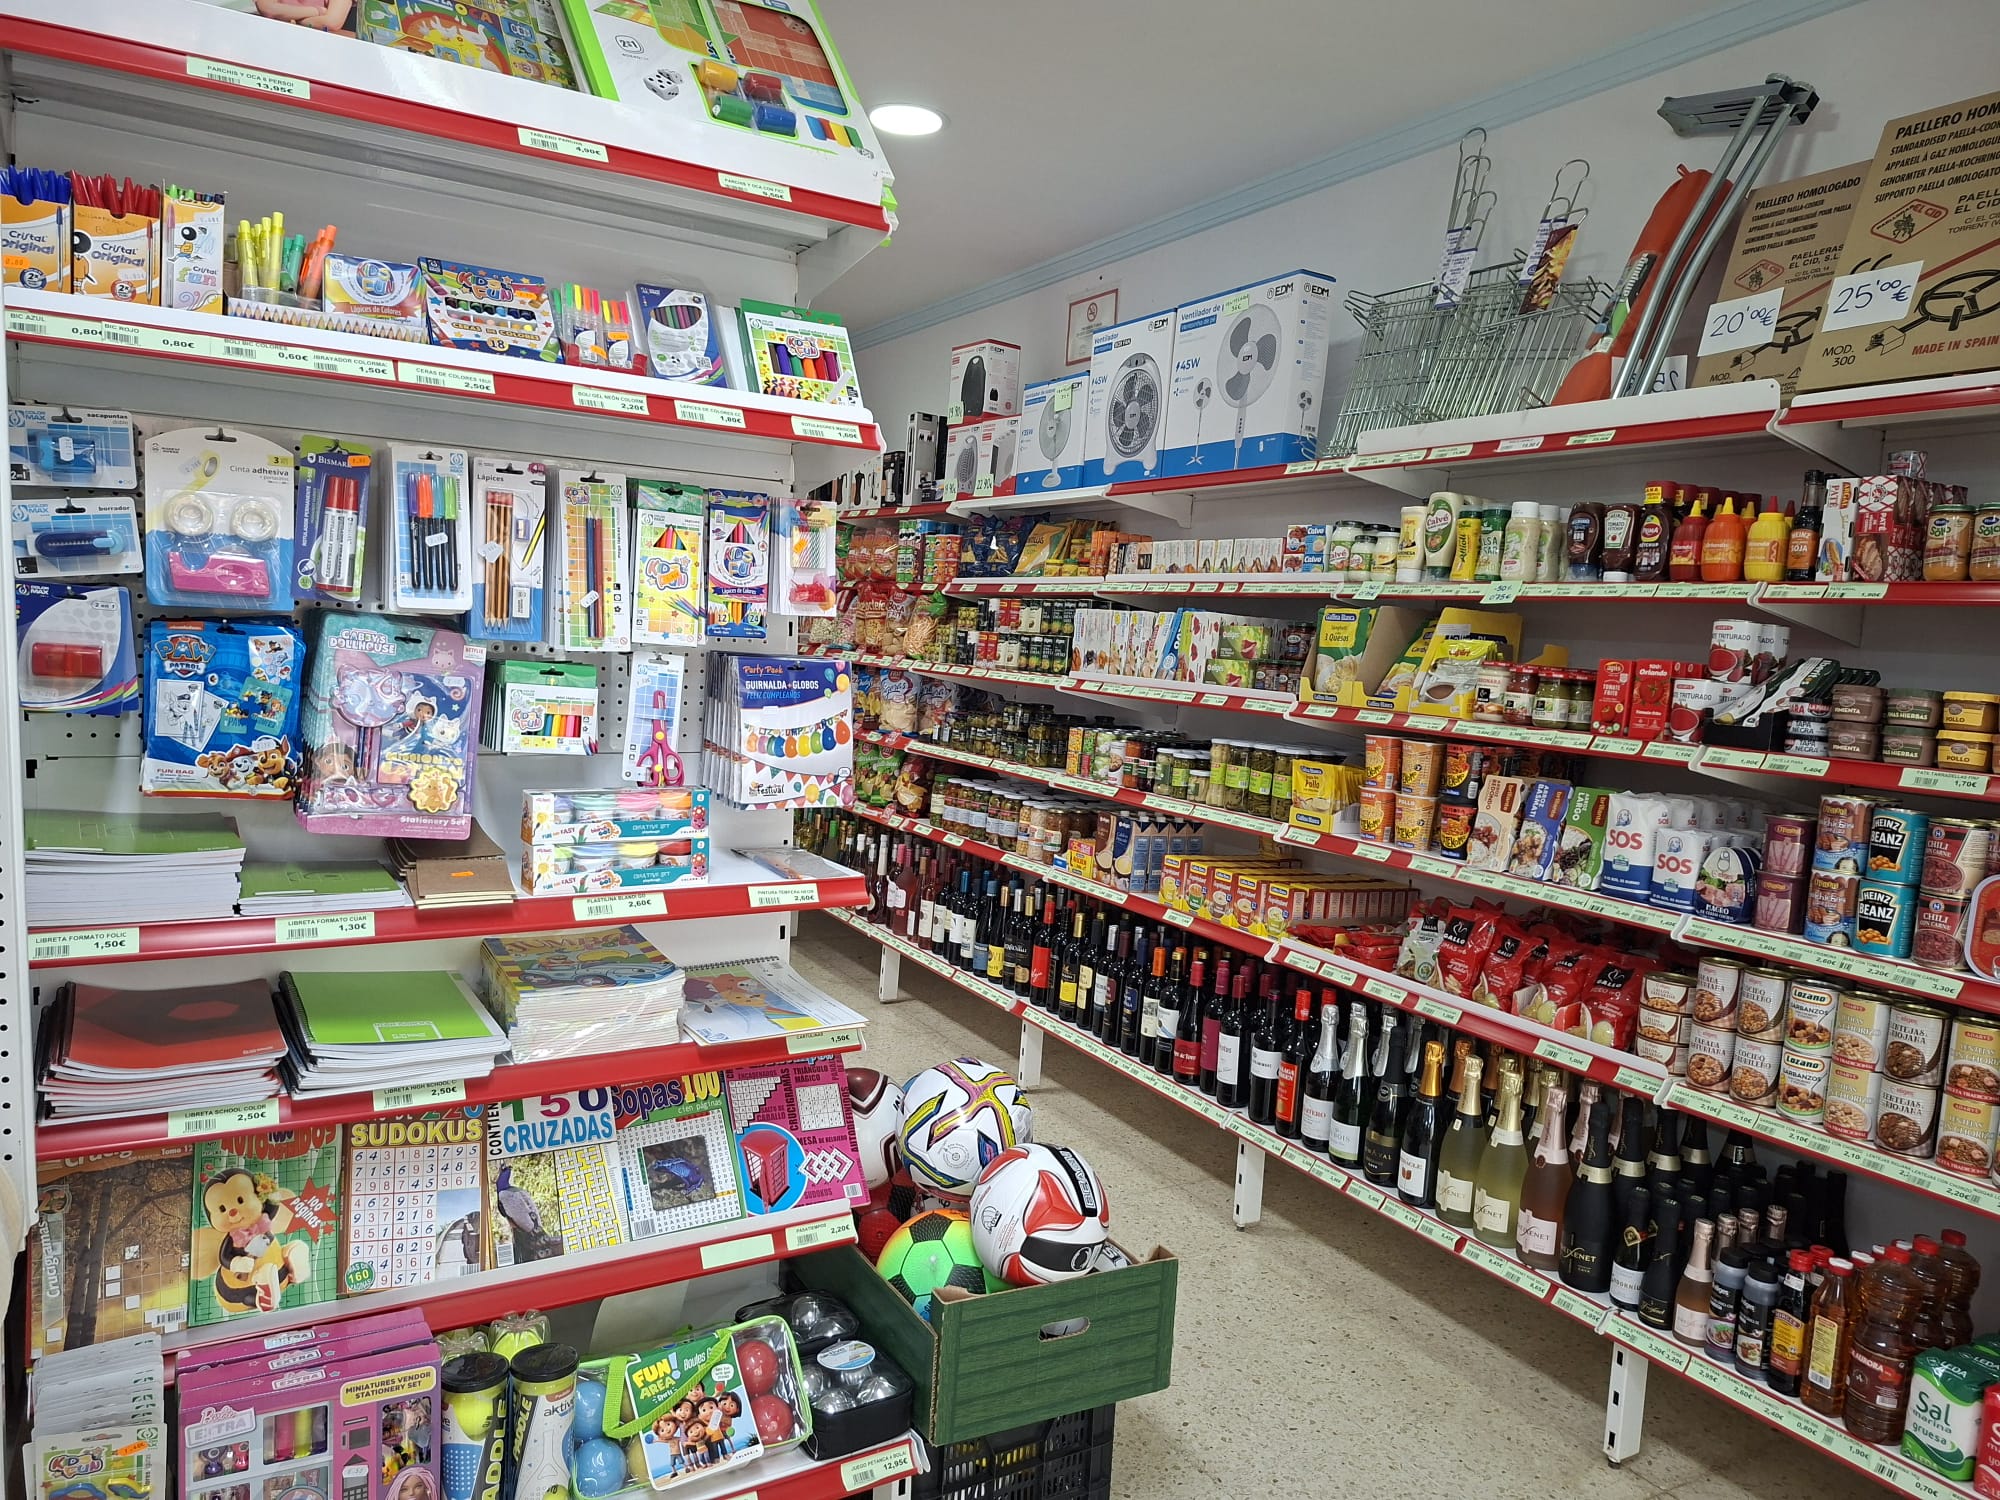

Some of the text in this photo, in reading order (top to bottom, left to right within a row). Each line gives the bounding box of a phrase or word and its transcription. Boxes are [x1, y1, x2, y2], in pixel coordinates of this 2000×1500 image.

[207, 65, 238, 76] PARCHIS
[256, 82, 294, 94] 13,95€
[1895, 111, 1963, 140] PAELLERO
[1890, 134, 1946, 156] STANDARDISED
[1885, 148, 1947, 171] APPAREIL GAZ
[1879, 168, 1925, 188] GENORMTER
[1754, 176, 1861, 210] PAELLERO HOMOLOGADO
[1874, 179, 1945, 204] SUPPORTO PAELLA
[9, 230, 47, 243] Cristal
[101, 242, 139, 256] Cristal
[1791, 244, 1845, 261] PAELLERAS
[192, 265, 217, 276] Cristal
[1275, 282, 1294, 297] EDM
[1311, 284, 1329, 297] EDM
[25, 314, 46, 322] AZUL
[1181, 304, 1221, 321] Ventilador de
[120, 325, 140, 333] ROJO
[1154, 318, 1169, 329] EDM
[162, 339, 195, 349] 0,80€
[490, 339, 505, 349] 18
[1094, 333, 1119, 344] Ventilador
[1822, 345, 1855, 357] MOD.
[1912, 334, 2000, 356] MADE IN SPAIN
[278, 352, 309, 362] 0,60€
[1832, 355, 1856, 367] 300
[1180, 357, 1201, 371] 45W
[359, 366, 388, 375] 1,50€
[416, 367, 477, 382] CERAS COLORES
[464, 381, 492, 391] 2,50€
[252, 467, 289, 476] adhesiva
[477, 474, 504, 483] Lápices
[1426, 512, 1450, 526] Calvé
[1307, 525, 1325, 535] Calvo
[1791, 532, 1811, 540] HEINZ
[1791, 544, 1808, 552] SOJA
[1304, 555, 1325, 564] Calvo
[31, 588, 49, 596] MAX
[1329, 634, 1350, 643] Quesos
[1718, 632, 1751, 641] TRITURADO
[155, 640, 216, 663] PAW
[328, 637, 396, 654] DOLLHOUSE
[169, 663, 201, 671] PATROL
[743, 666, 764, 677] Party
[1639, 669, 1668, 677] Orlando
[745, 681, 819, 690] GUIRNALDA GLOBOS
[746, 691, 762, 699] FELIZ
[1680, 692, 1712, 701] TRITURADO
[1899, 712, 1928, 721] HIERBAS
[1794, 726, 1814, 734] NEGRA
[1892, 750, 1919, 758] HIERBAS
[1947, 755, 1970, 763] POLLO
[1955, 780, 1977, 788] 1,70€
[1529, 784, 1543, 818] BASMATI
[1573, 792, 1583, 821] LARGO
[401, 816, 448, 827] Stationery
[1874, 817, 1902, 830] HEINZ
[1608, 829, 1642, 850] SOS
[1871, 831, 1902, 846] BEANZ
[1928, 840, 1949, 851] CHILI
[1658, 854, 1692, 875] SOS
[628, 900, 652, 908] 2,60€
[1863, 891, 1891, 905] HEINZ
[1706, 903, 1729, 914] MAGRO
[1859, 903, 1894, 920] BEANZ
[288, 917, 348, 927] LIBRETA FORMATO
[1923, 913, 1949, 924] CHILI
[338, 923, 367, 932] 1,30€
[35, 932, 105, 944] LIBRETA FORMATO
[1443, 933, 1465, 945] GALLO
[93, 940, 126, 950] 1,50€
[1816, 956, 1837, 967] 2,60€
[1932, 983, 1955, 994] 3,30€
[1794, 988, 1826, 1003] Lozano
[831, 1034, 850, 1043] 1,50€
[1786, 1056, 1819, 1069] Lozano
[793, 1064, 829, 1075] TRIÁNGULO
[795, 1073, 820, 1083] MÁGICO
[384, 1086, 409, 1095] LIBRETA
[426, 1081, 450, 1089] SCHOOL
[431, 1086, 457, 1096] 2,50€
[611, 1071, 721, 1120] Sopas 100
[781, 1068, 799, 1131] CRUCIGRAMAS
[184, 1103, 266, 1119] LIBRETA SCHOOL COLOR
[678, 1100, 722, 1114] cien páginas
[237, 1111, 267, 1122] 2,50€
[351, 1119, 483, 1147] SUDOKUS
[503, 1112, 613, 1153] CRUZADAS
[1789, 1133, 1807, 1144] 2,10€
[804, 1187, 832, 1199] SUDOKUS
[306, 1195, 324, 1212] 100
[830, 1224, 851, 1235] 2,20€
[39, 1219, 62, 1298] Crucigramas
[348, 1269, 369, 1283] 160
[1973, 1356, 2000, 1370] LEDA
[1940, 1361, 1968, 1378] LEDA
[345, 1371, 431, 1394] MINIATURES VENDOR
[1699, 1371, 1718, 1383] 2,95€
[355, 1380, 422, 1400] STATIONERY SET
[640, 1379, 676, 1400] AREA
[1733, 1388, 1753, 1400] 2,60€
[1764, 1407, 1784, 1421] 2,40€
[1916, 1391, 1951, 1426] Sal
[1913, 1409, 1952, 1434] marina
[513, 1397, 533, 1462] PADDLE
[1912, 1422, 1947, 1445] gruesa
[1849, 1445, 1869, 1460] 1,90€
[852, 1457, 887, 1472] JUEGO PETANCA
[883, 1460, 908, 1471] 12,95€
[1915, 1482, 1939, 1497] 0,70€
